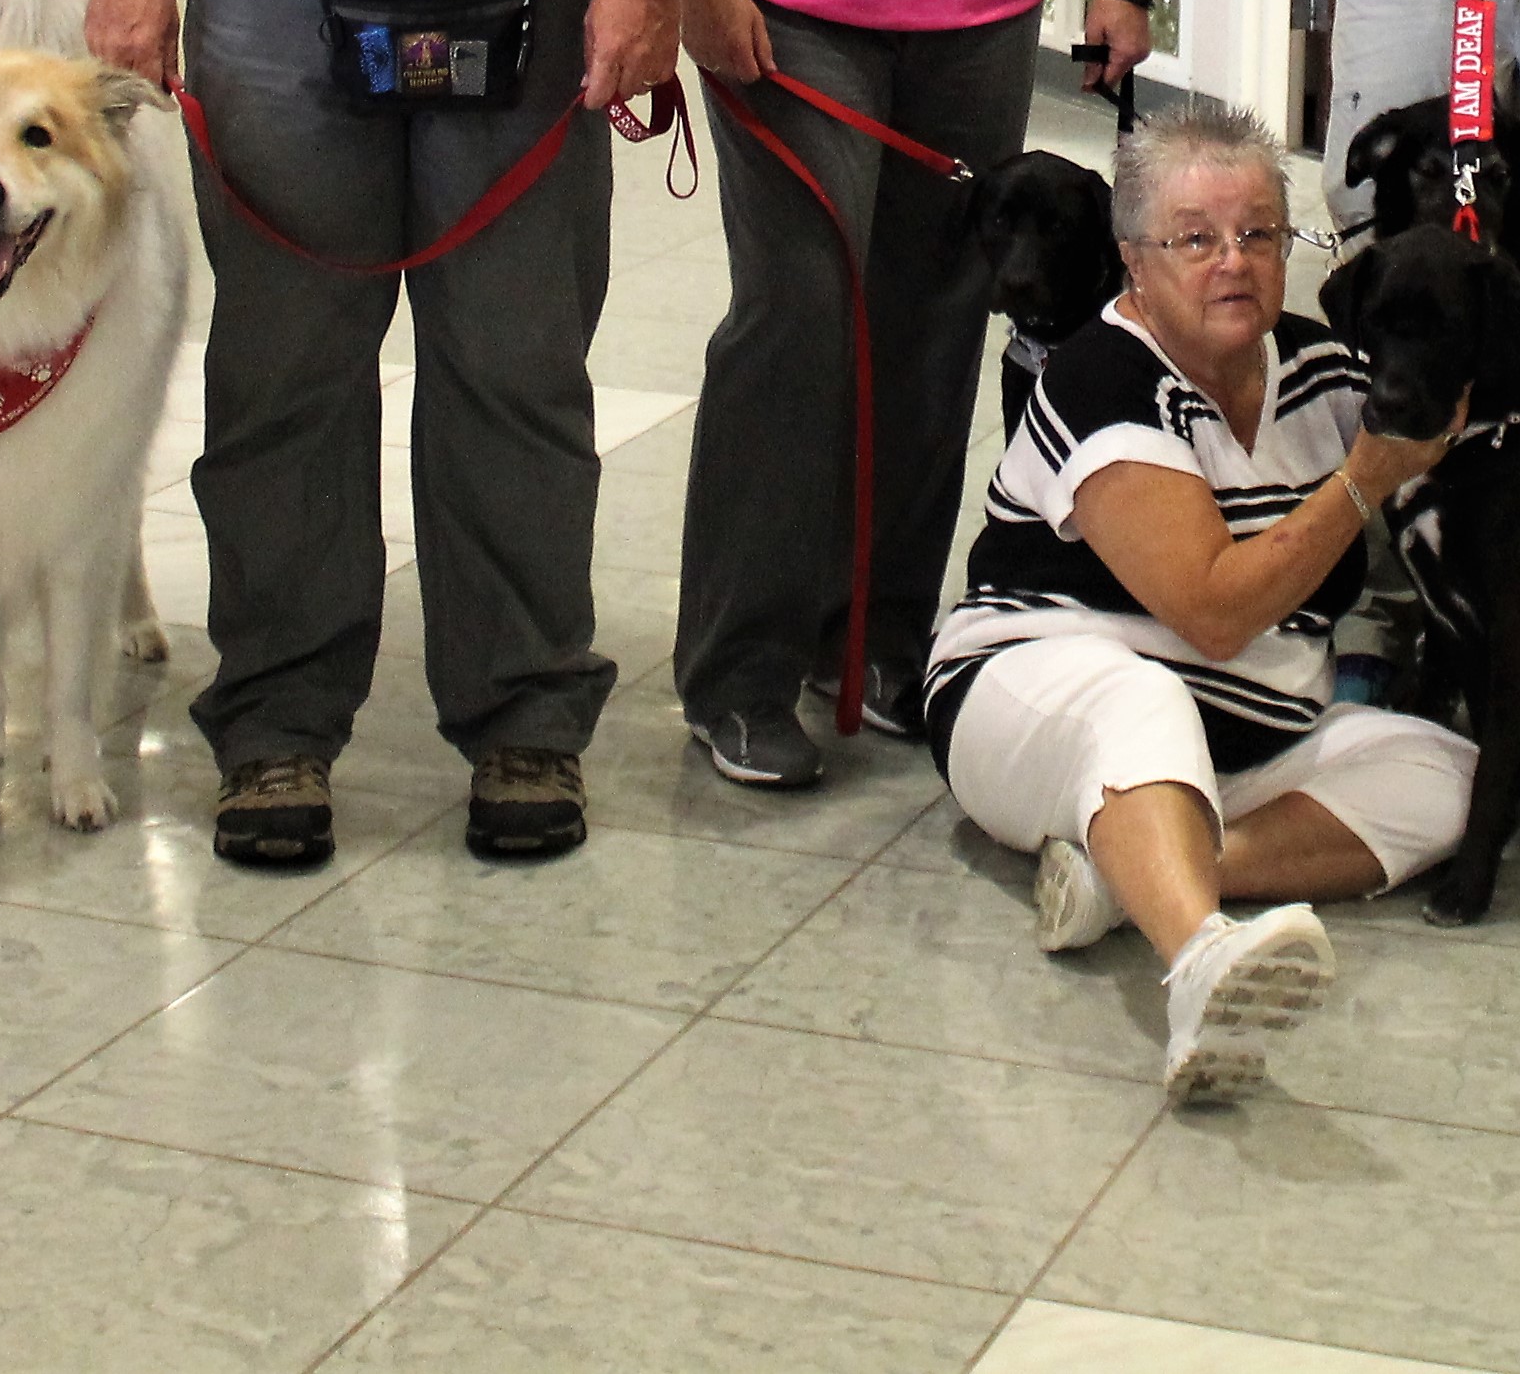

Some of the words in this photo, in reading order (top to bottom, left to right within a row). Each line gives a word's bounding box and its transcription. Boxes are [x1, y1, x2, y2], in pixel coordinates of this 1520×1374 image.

[1455, 7, 1483, 74] DEAF
[1453, 80, 1481, 117] AM
[1454, 126, 1479, 139] I
